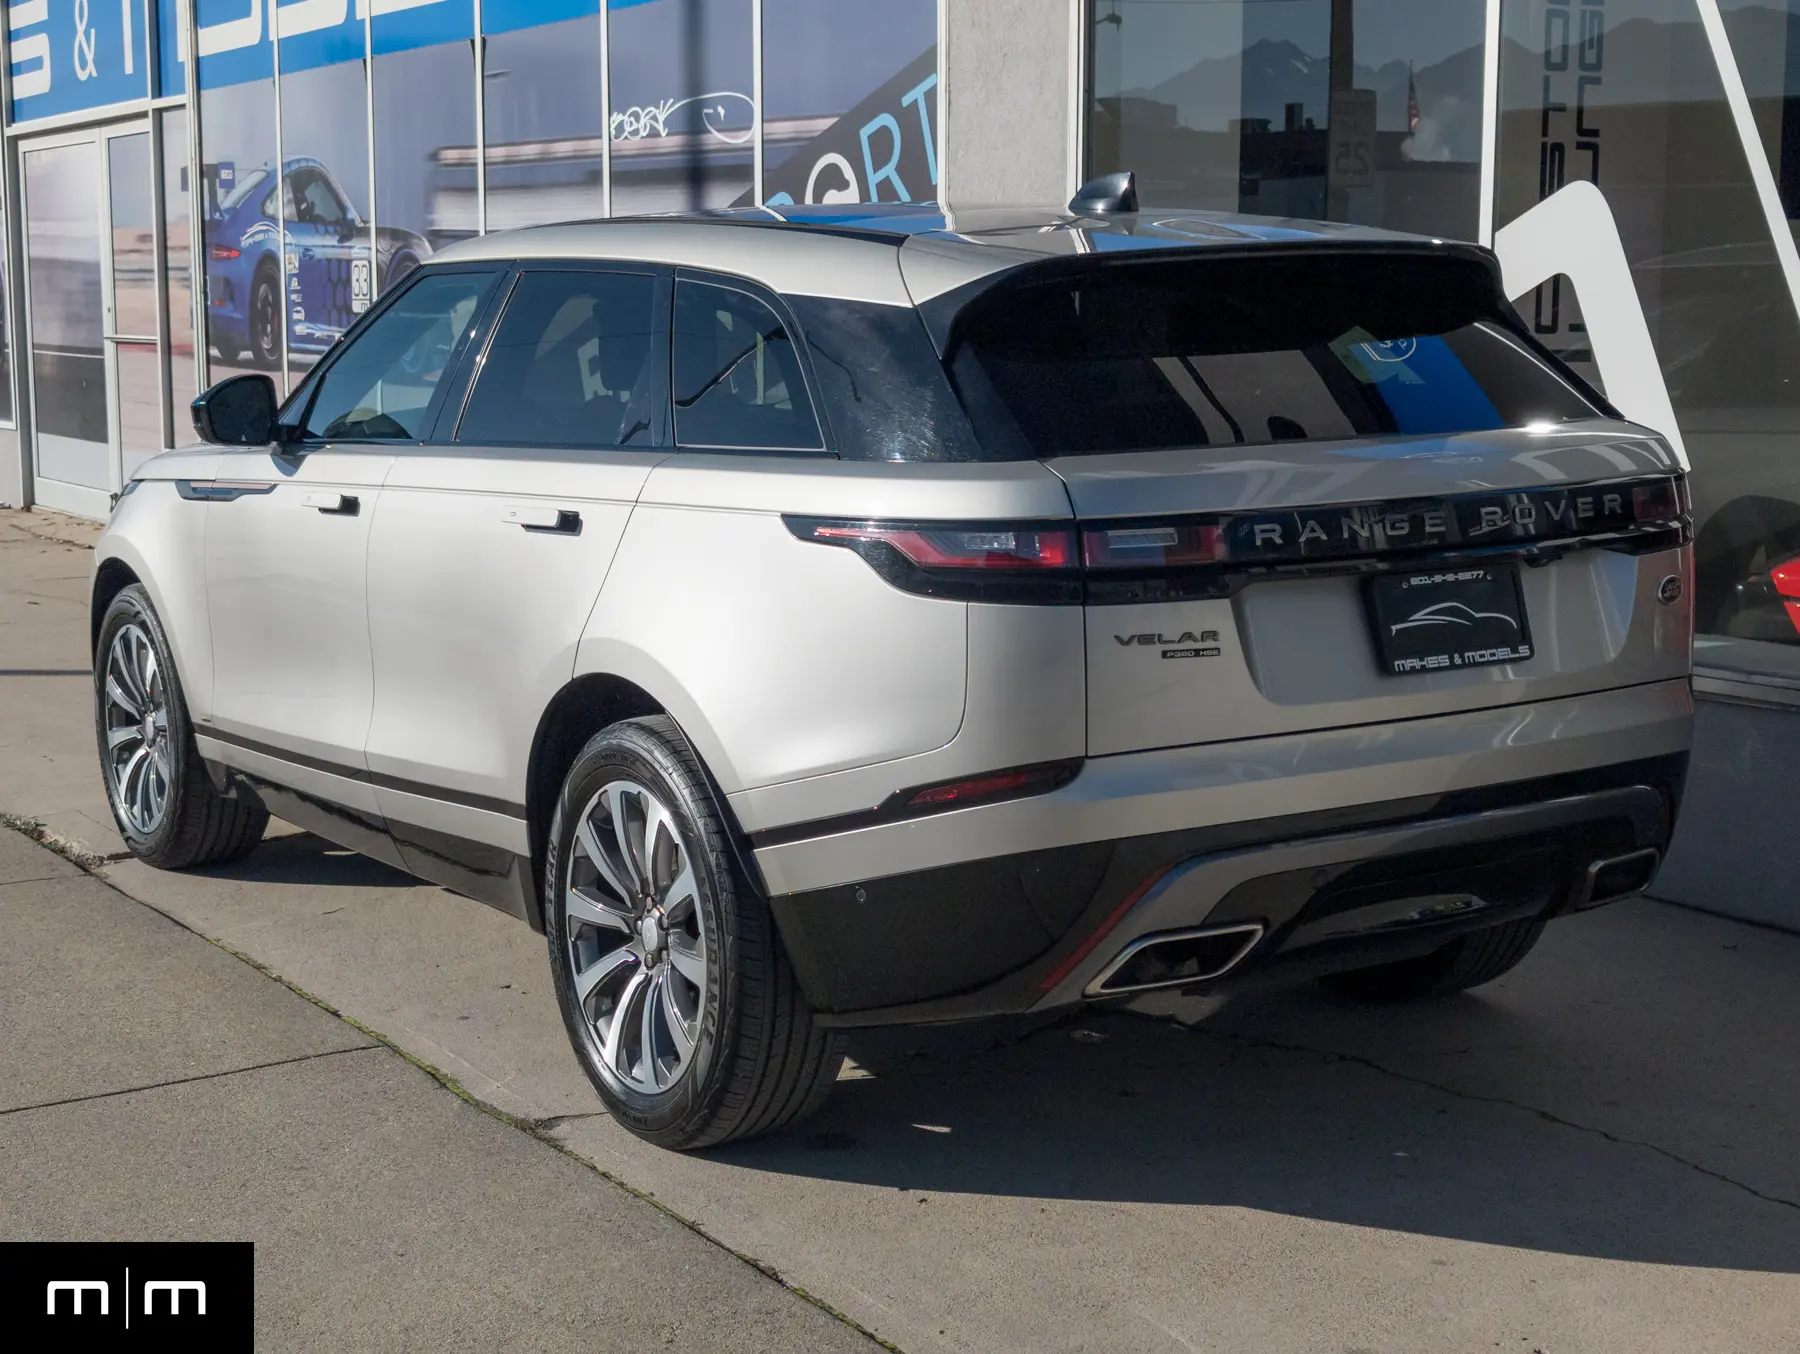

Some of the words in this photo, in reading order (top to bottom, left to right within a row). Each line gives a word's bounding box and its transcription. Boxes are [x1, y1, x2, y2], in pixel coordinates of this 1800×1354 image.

[353, 264, 369, 297] 33
[1253, 511, 1447, 546] RANGE
[1479, 493, 1622, 532] ROVER
[1113, 630, 1220, 646] VELAR
[1394, 654, 1450, 672] MAKES
[1453, 653, 1462, 665] &
[1464, 645, 1531, 664] MODELS
